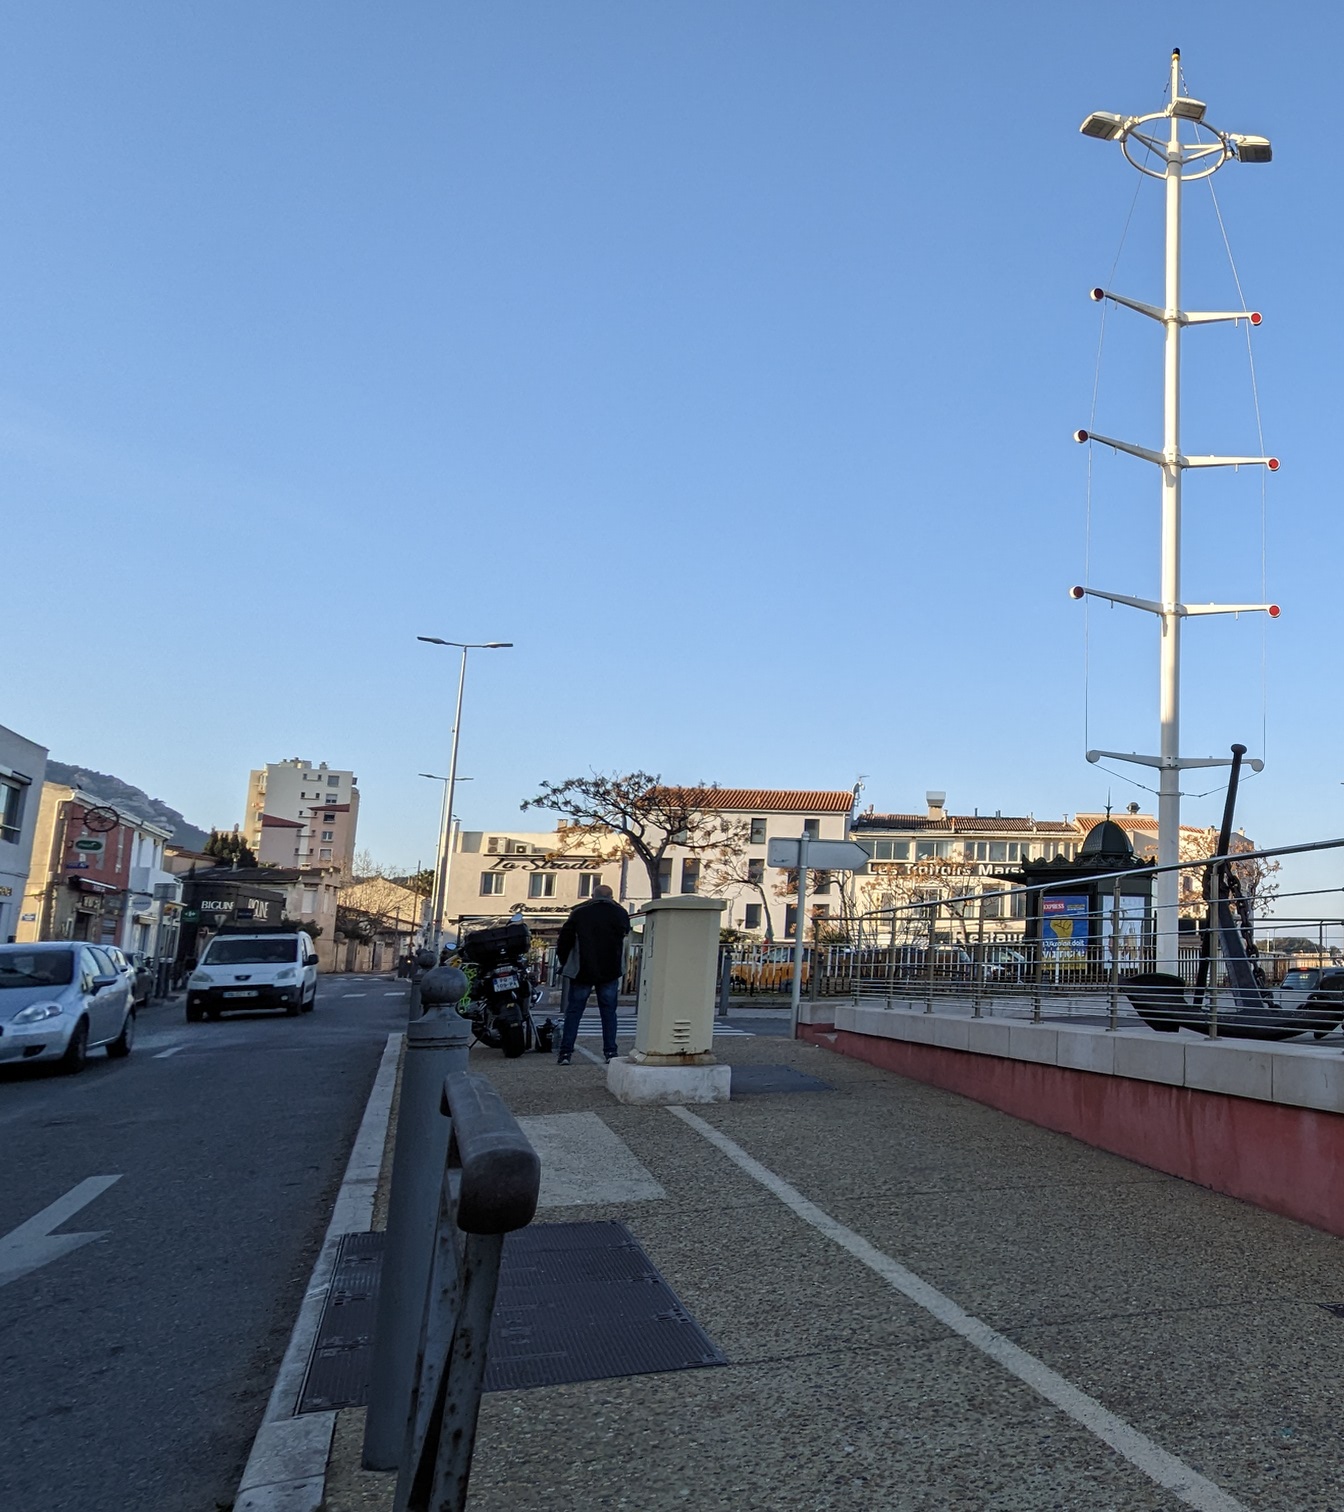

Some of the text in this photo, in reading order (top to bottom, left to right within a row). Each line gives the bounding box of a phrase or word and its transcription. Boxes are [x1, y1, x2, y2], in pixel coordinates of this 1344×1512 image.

[488, 857, 601, 871] La Strada
[867, 863, 898, 875] Les
